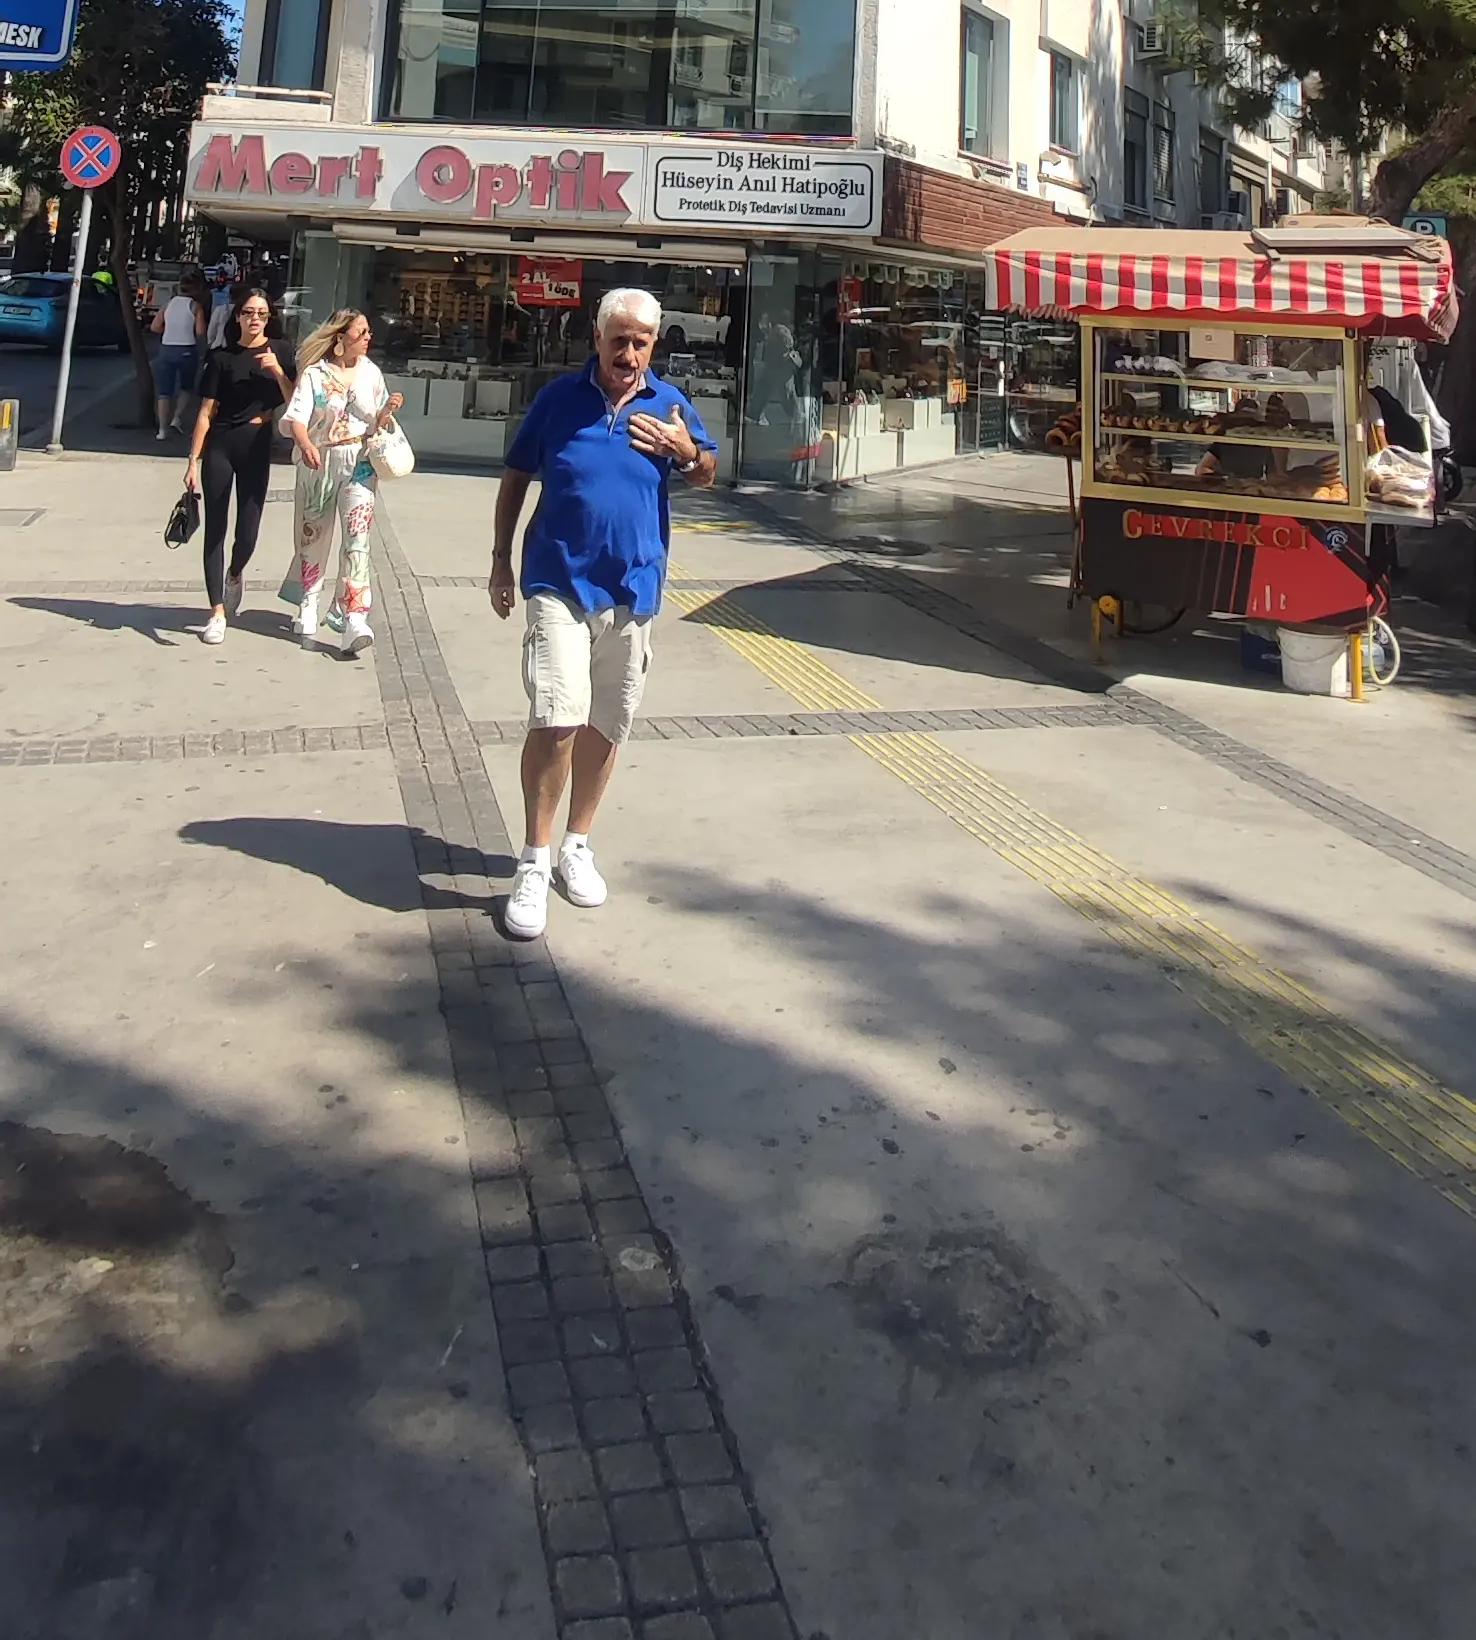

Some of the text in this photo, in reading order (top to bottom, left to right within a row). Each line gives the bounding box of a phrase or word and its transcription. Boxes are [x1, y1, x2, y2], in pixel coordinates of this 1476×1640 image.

[716, 151, 811, 173] Diş Hekimi
[194, 134, 634, 219] Mert Optik
[661, 171, 866, 200] Hüseyin Anıl Hatipoğlu
[678, 198, 846, 218] Protetik Diş Tedavisi Uzmanı
